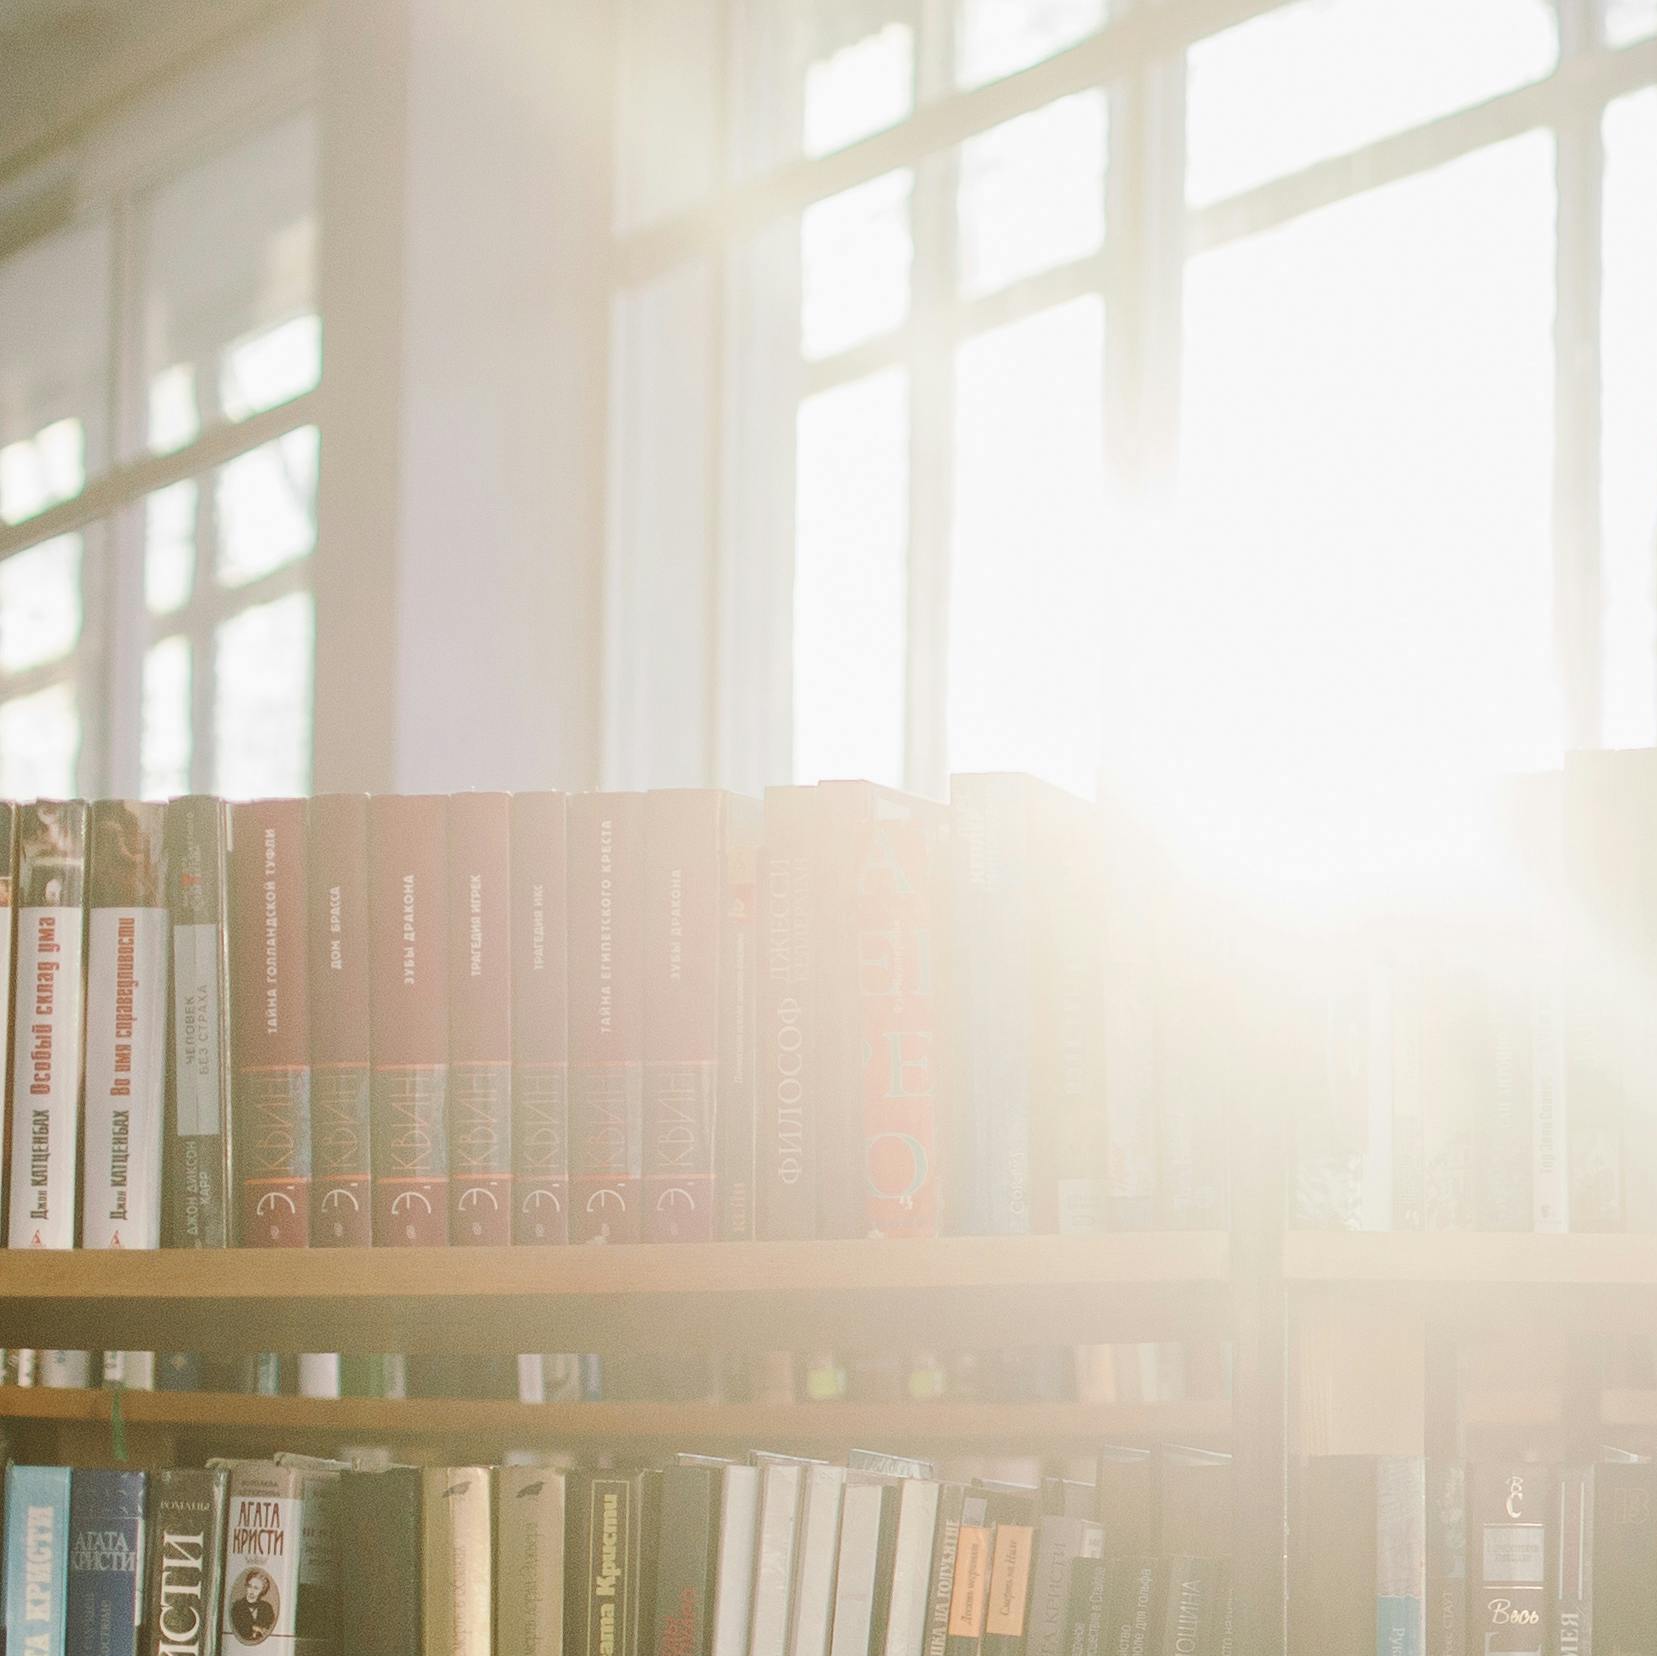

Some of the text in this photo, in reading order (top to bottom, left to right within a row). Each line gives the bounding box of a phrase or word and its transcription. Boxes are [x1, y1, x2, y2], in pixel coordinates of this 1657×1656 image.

[470, 875, 481, 976] ТРАГЕДИЯ ИГРЕК
[601, 821, 612, 1033] ТАЙНА ЕГИПЕТСКОГО КРЕСТА
[184, 996, 195, 1065] ЧЕЛОВЕК
[777, 998, 802, 1184] ФИЛОСОФ
[26, 1506, 53, 1621] КРИСТИ
